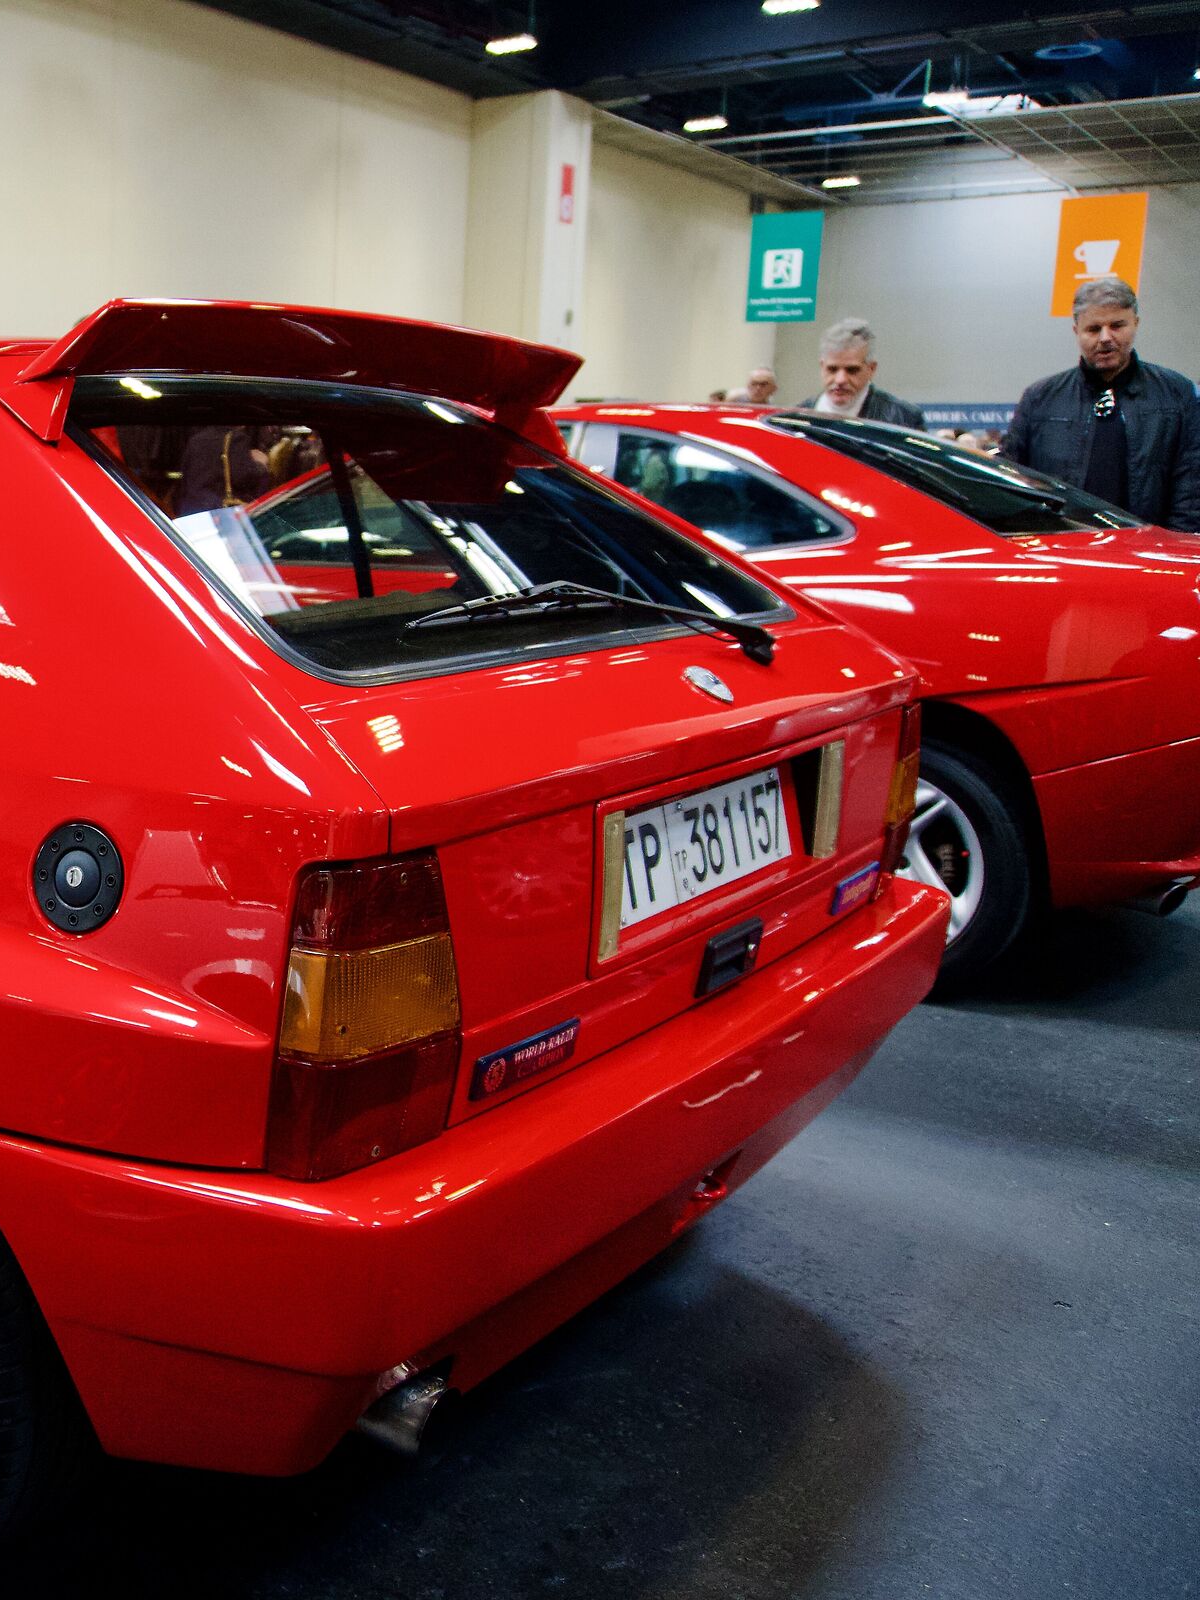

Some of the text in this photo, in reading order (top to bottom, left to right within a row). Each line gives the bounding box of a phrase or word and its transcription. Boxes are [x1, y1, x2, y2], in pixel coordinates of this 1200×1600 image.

[624, 779, 779, 910] TP 381157
[674, 849, 688, 872] TP
[514, 1040, 547, 1065] WORLD
